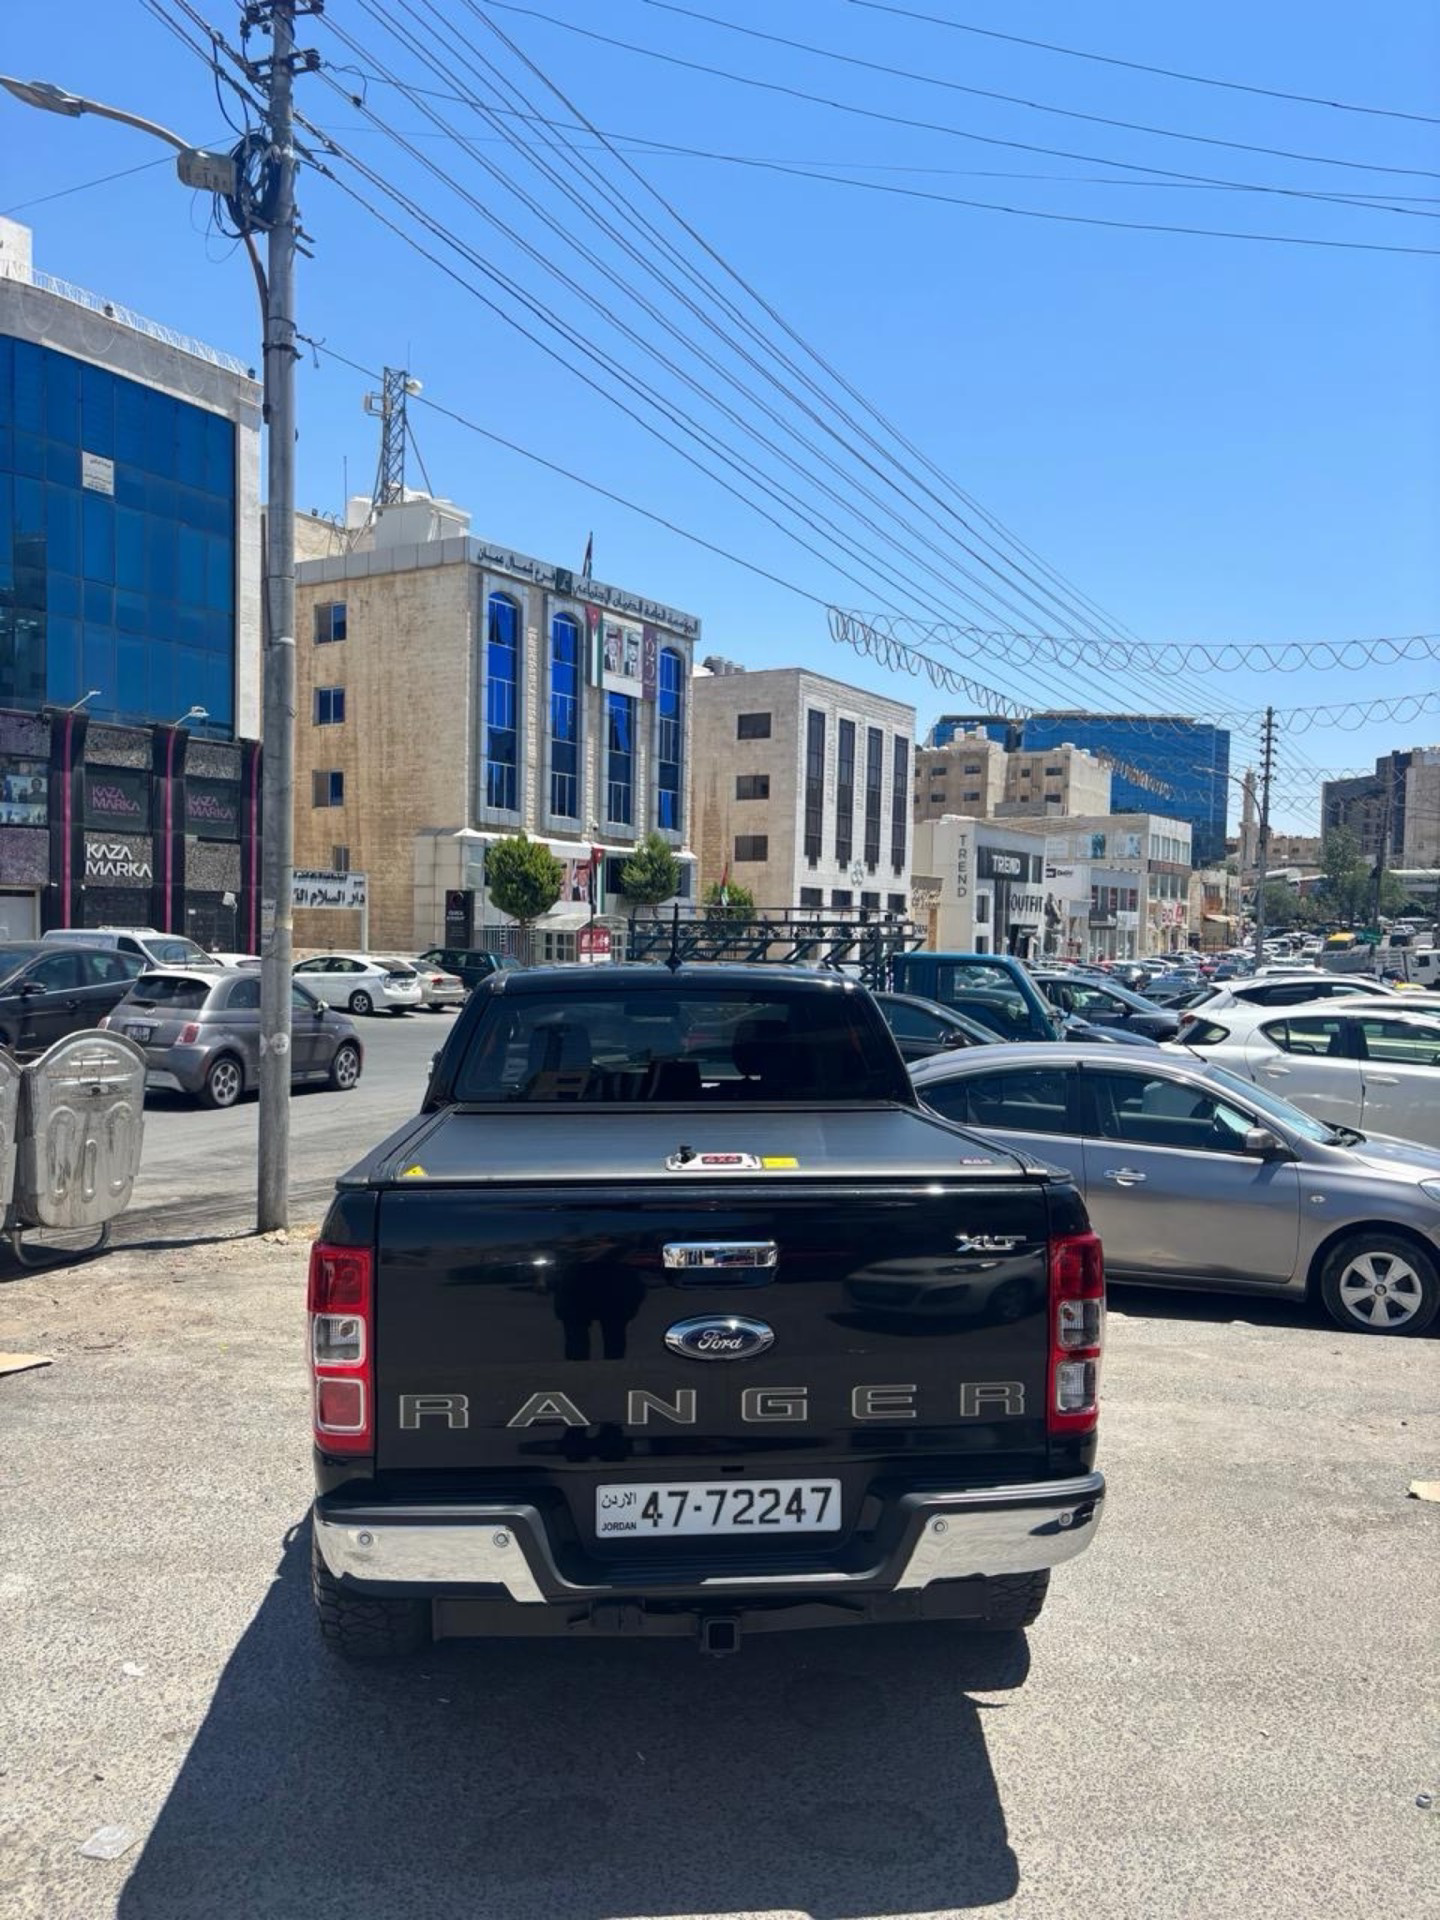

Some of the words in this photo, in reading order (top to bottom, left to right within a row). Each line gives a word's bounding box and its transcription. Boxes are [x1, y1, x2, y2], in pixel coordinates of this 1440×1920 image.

[92, 785, 125, 799] KAZA
[188, 794, 219, 807] KAZA
[92, 797, 141, 812] MARKA
[188, 805, 237, 819] MARKA
[85, 843, 133, 861] KAZA
[85, 860, 153, 878] MARKA
[957, 834, 968, 898] TREND
[991, 854, 1021, 876] TREND
[309, 888, 346, 907] السلام
[1010, 893, 1044, 913] OUTFIT
[955, 1234, 1027, 1252] XLT
[697, 1329, 745, 1350] Ford
[398, 1381, 1026, 1430] RANGER
[641, 1486, 833, 1528] 47-72247
[601, 1521, 637, 1532] JORDAN
